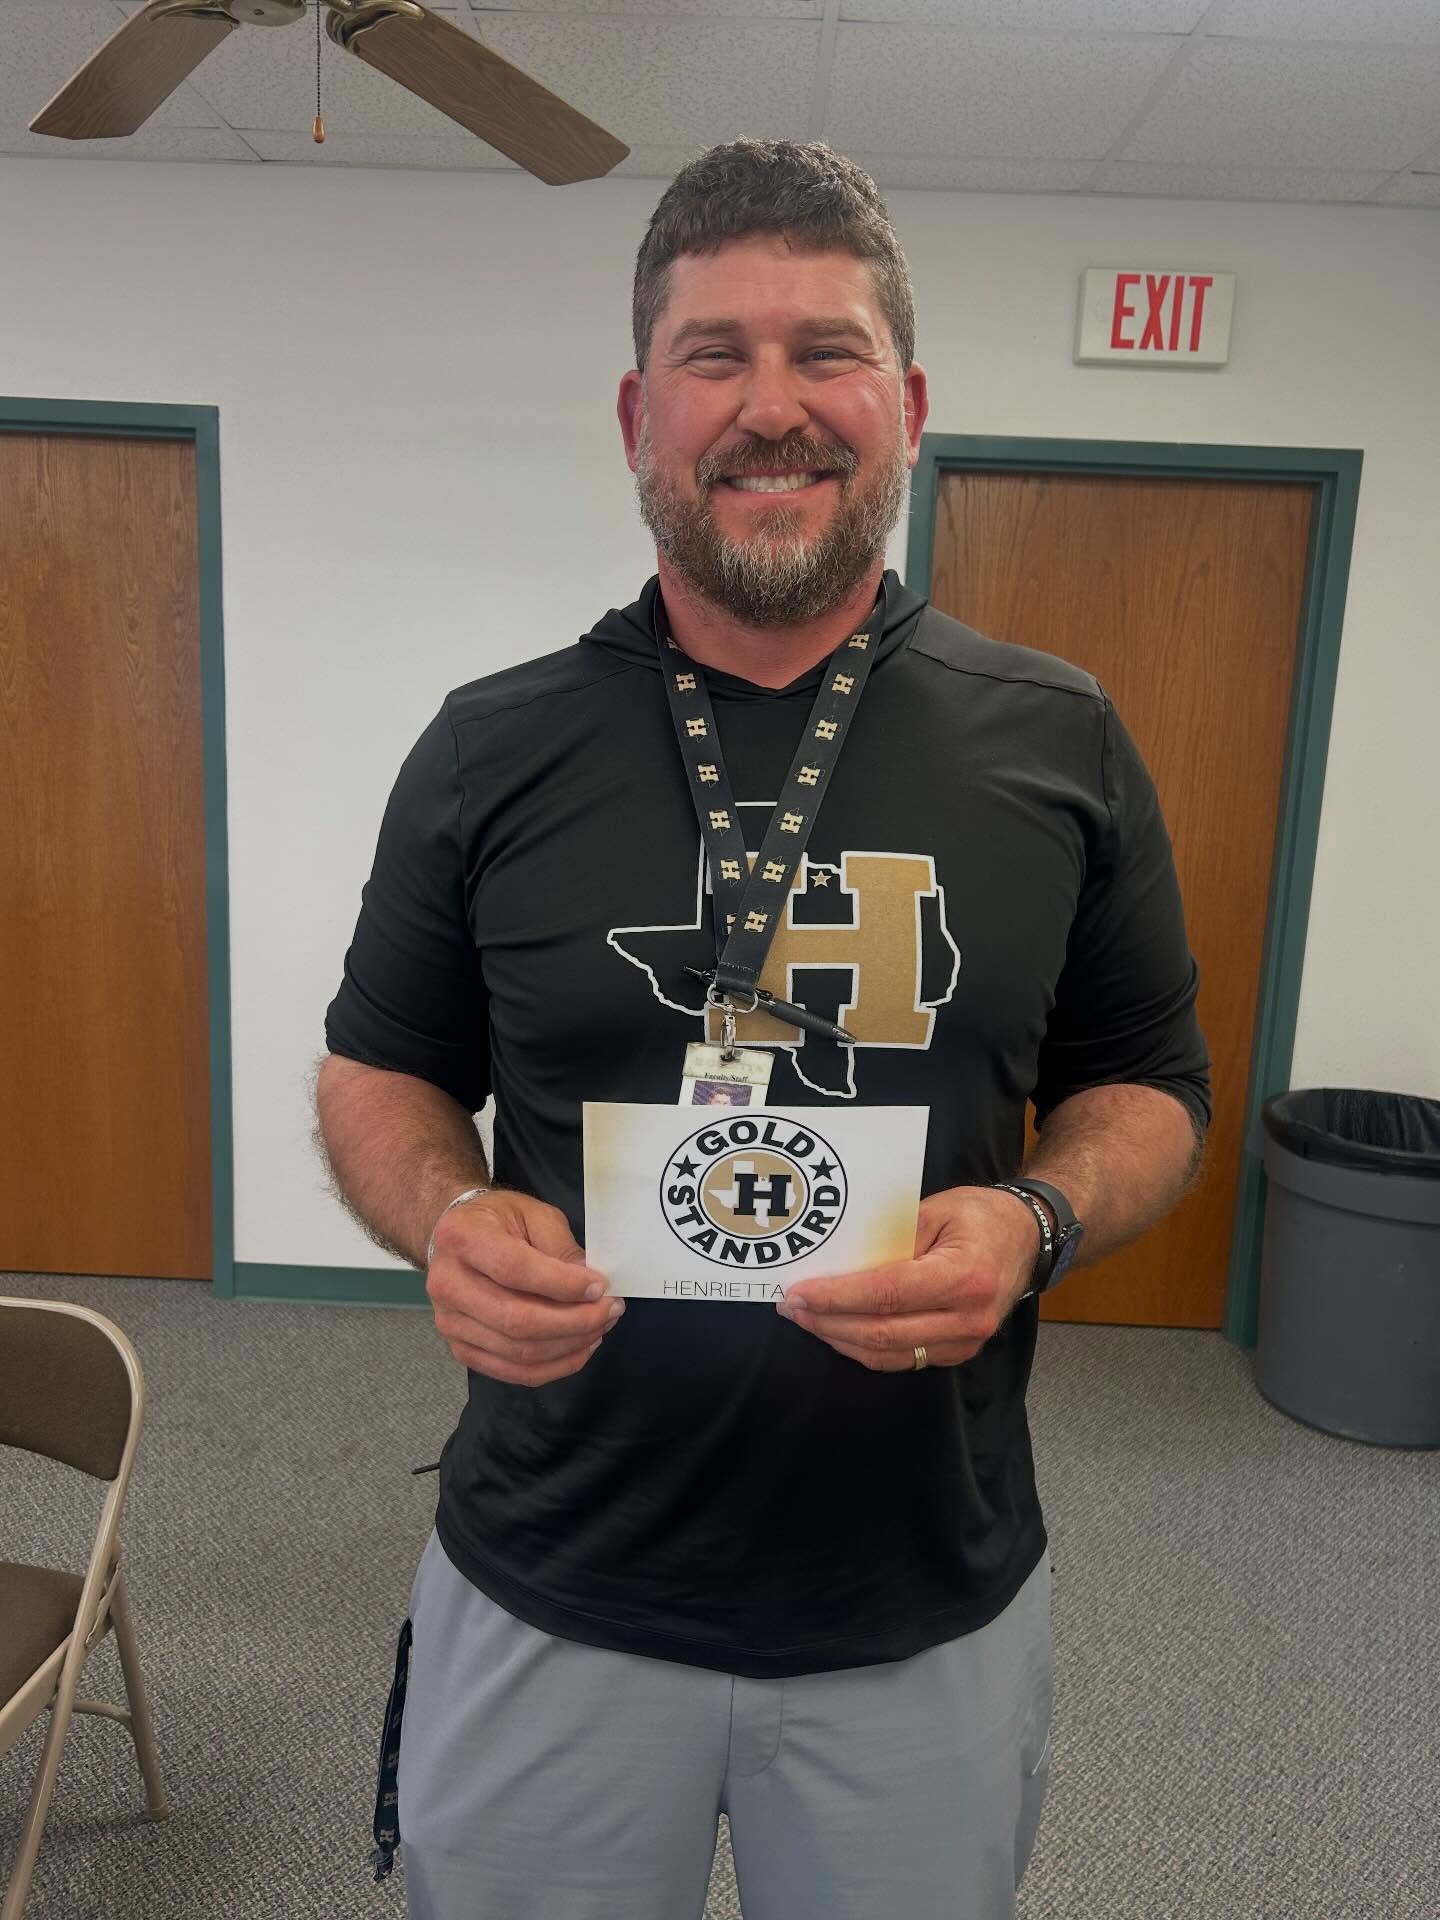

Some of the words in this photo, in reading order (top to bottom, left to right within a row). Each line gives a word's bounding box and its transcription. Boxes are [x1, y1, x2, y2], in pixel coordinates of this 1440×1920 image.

[1110, 273, 1214, 352] EXIT
[676, 673, 697, 691] H
[832, 673, 855, 695] H
[686, 718, 707, 736] H
[814, 719, 838, 741] H
[698, 764, 719, 783] H
[797, 766, 821, 786] H
[709, 810, 730, 829] H
[780, 812, 804, 834] H
[720, 859, 742, 880] H
[763, 861, 786, 883] H
[744, 911, 769, 933] H
[704, 851, 937, 1050] H
[696, 1120, 816, 1159] GOLD
[733, 1173, 792, 1217] H
[667, 1184, 841, 1265] STANDARD
[663, 1279, 785, 1299] HENRIETTA
